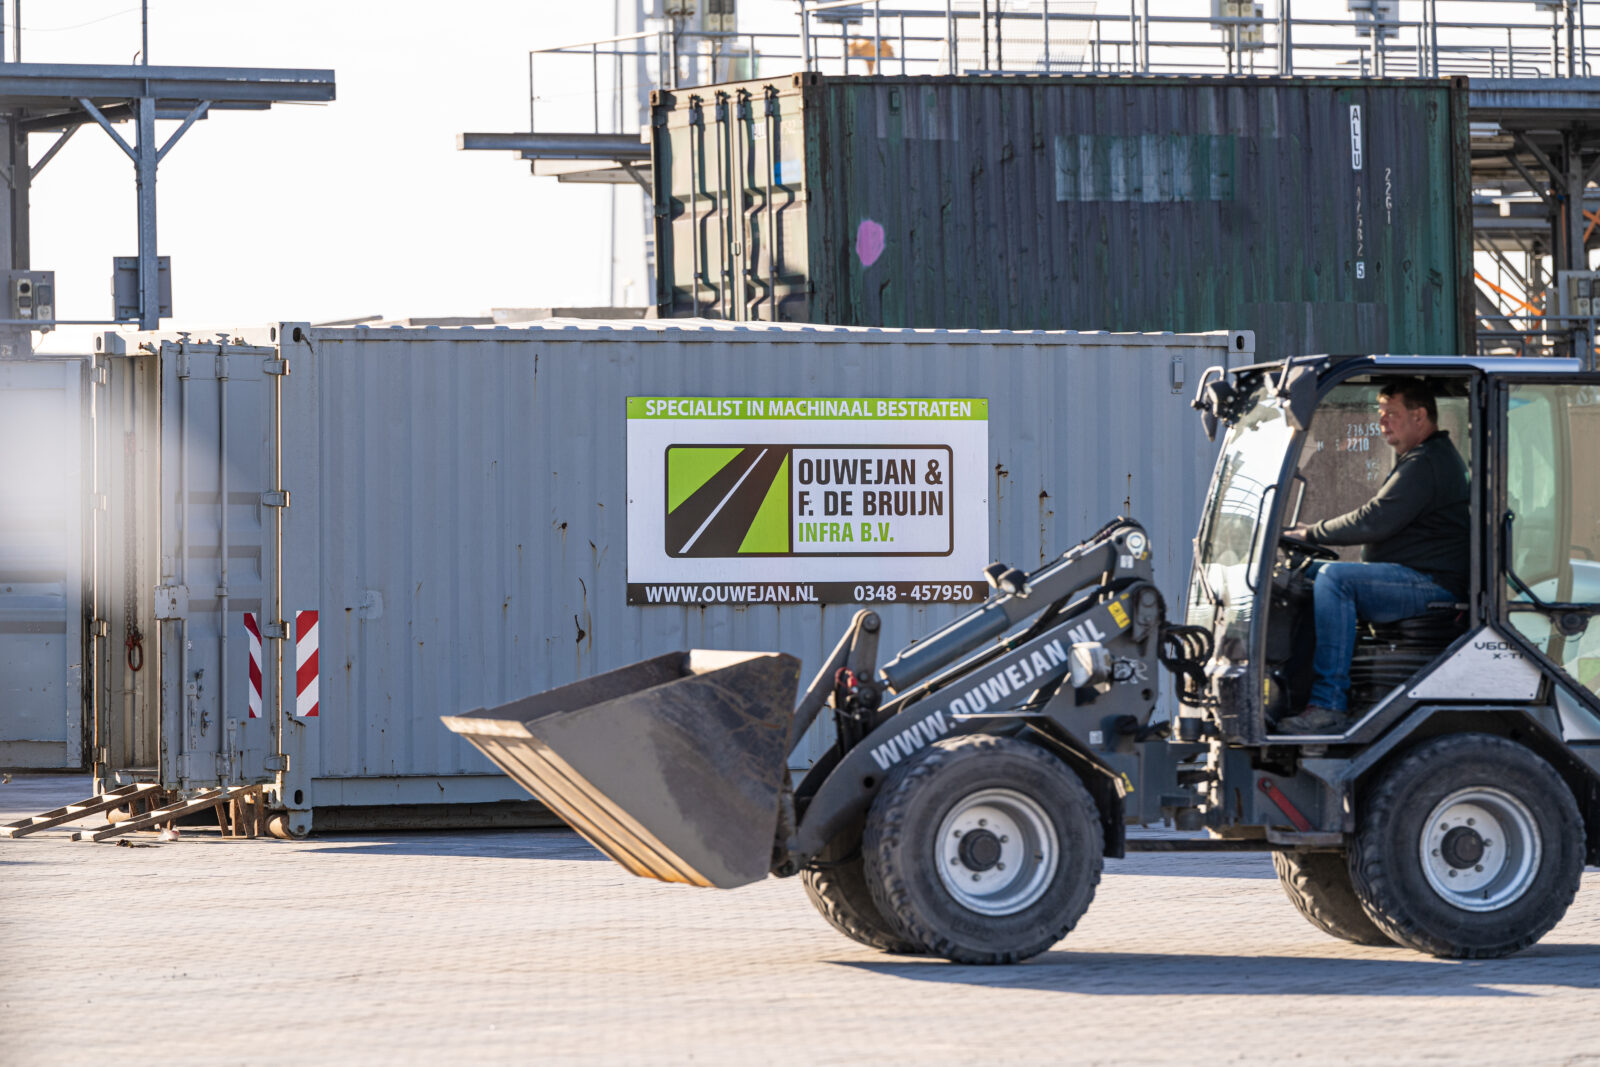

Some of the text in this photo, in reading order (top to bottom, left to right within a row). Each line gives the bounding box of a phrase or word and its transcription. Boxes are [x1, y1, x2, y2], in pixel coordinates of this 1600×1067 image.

[1352, 107, 1361, 168] ALLU
[646, 399, 972, 418] SPECIALIST IN MACHINAAL BESTRATEN
[1347, 437, 1369, 452] 2210
[798, 458, 944, 486] OUWEJAN &
[798, 490, 944, 517] F. DE BRUIJN
[798, 522, 895, 543] INFRA B.V.
[645, 585, 819, 603] WWW.OUWEJAN.NL
[853, 584, 897, 602] 0348
[910, 584, 973, 602] 457950
[869, 618, 1106, 771] WWW.OUWEJANNL
